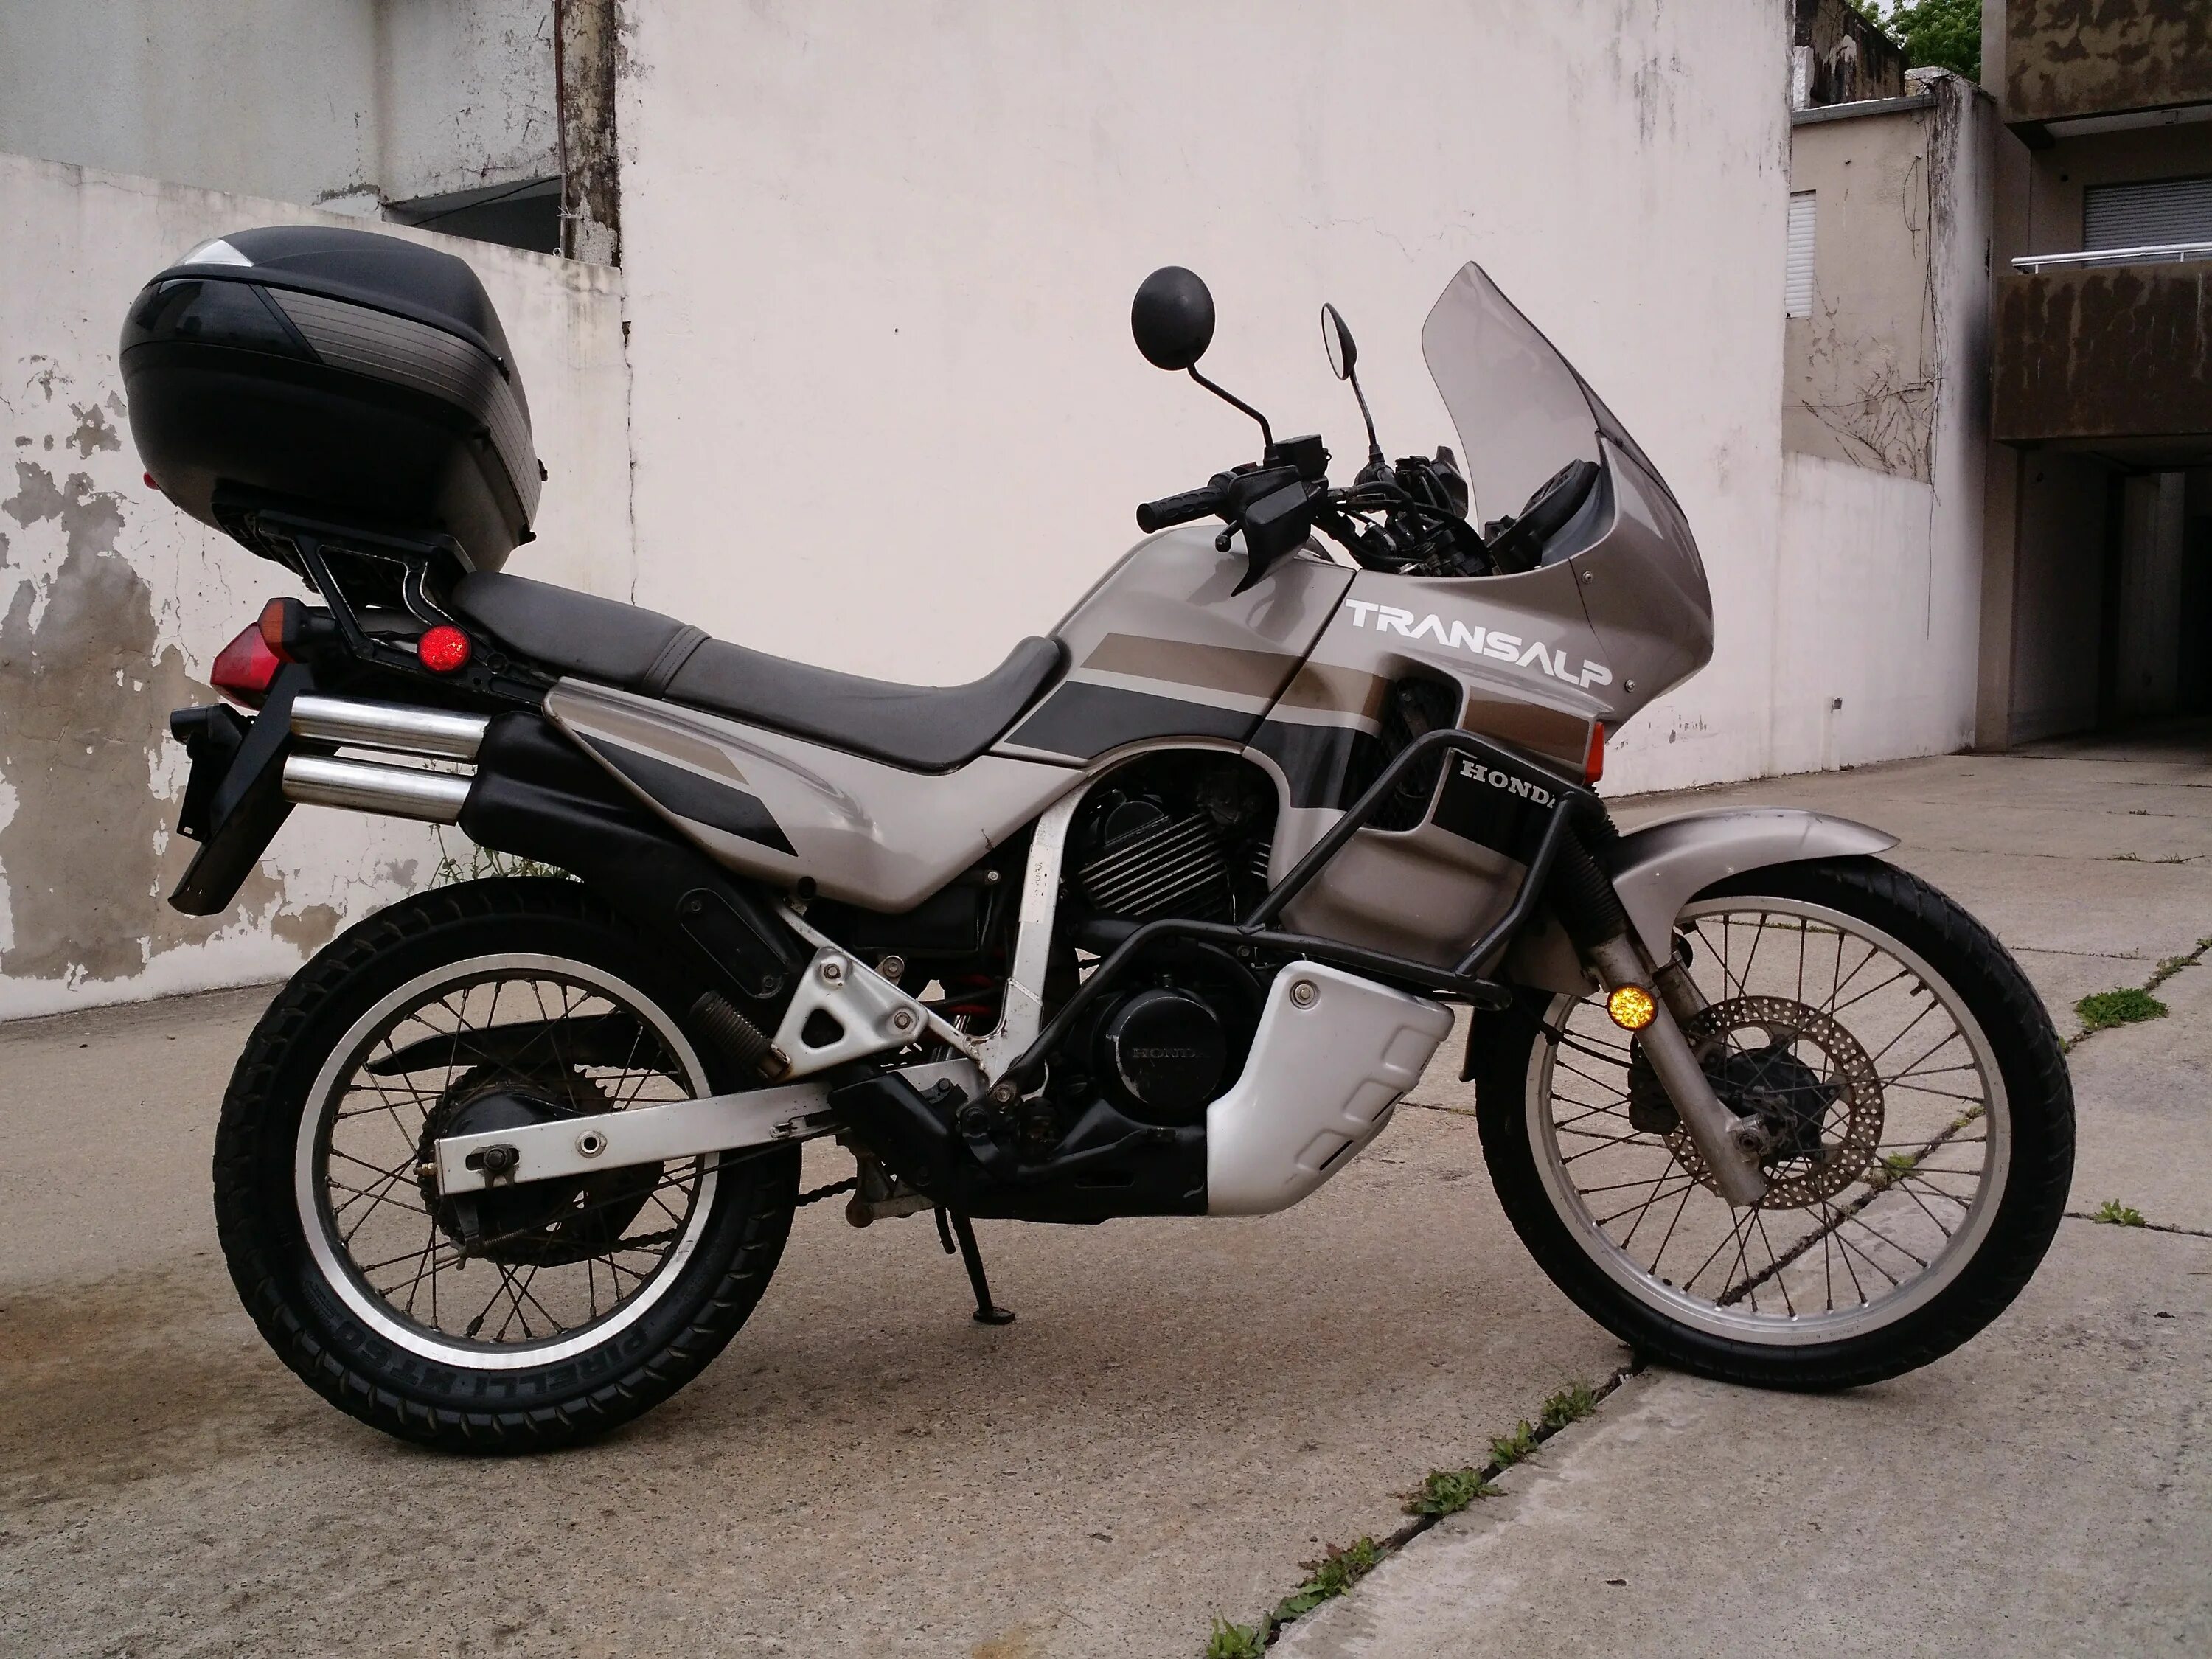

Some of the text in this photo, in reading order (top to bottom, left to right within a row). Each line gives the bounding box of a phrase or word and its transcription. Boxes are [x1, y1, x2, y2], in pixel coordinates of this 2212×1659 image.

[1345, 599, 1613, 689] TRANSALP
[1132, 1048, 1210, 1058] HOND
[473, 1326, 649, 1398] PIRELLI
